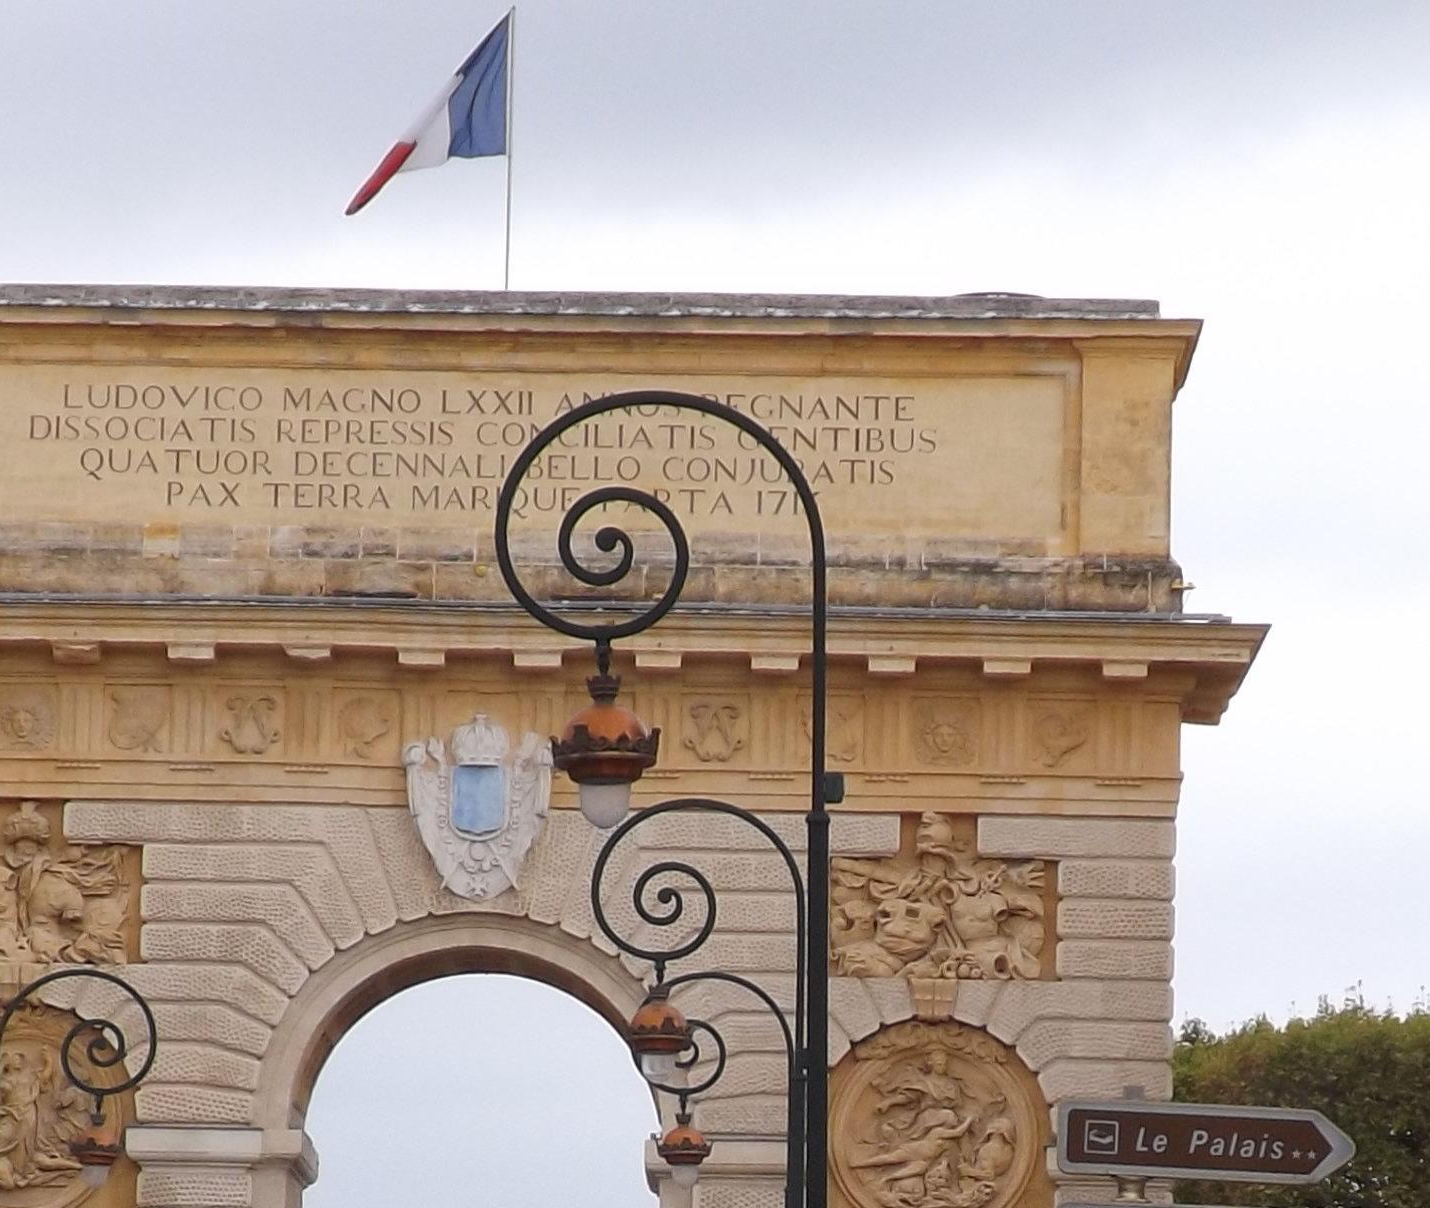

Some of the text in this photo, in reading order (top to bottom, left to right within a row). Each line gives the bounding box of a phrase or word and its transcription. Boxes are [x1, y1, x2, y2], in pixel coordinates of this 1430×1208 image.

[63, 384, 263, 411] LUDOVICO
[283, 387, 421, 414] MAGNO
[441, 389, 533, 416] LXXII
[28, 414, 257, 443] DISSOCIATIS
[276, 418, 455, 446] REPRESSIS
[79, 447, 273, 481] QUATUOR
[293, 451, 505, 479] DECENNALI
[525, 454, 641, 482] BELLO
[167, 480, 241, 507] PAX
[263, 482, 391, 509] TERRA
[756, 490, 821, 516] 171
[1135, 1126, 1285, 1160] Le Palais
